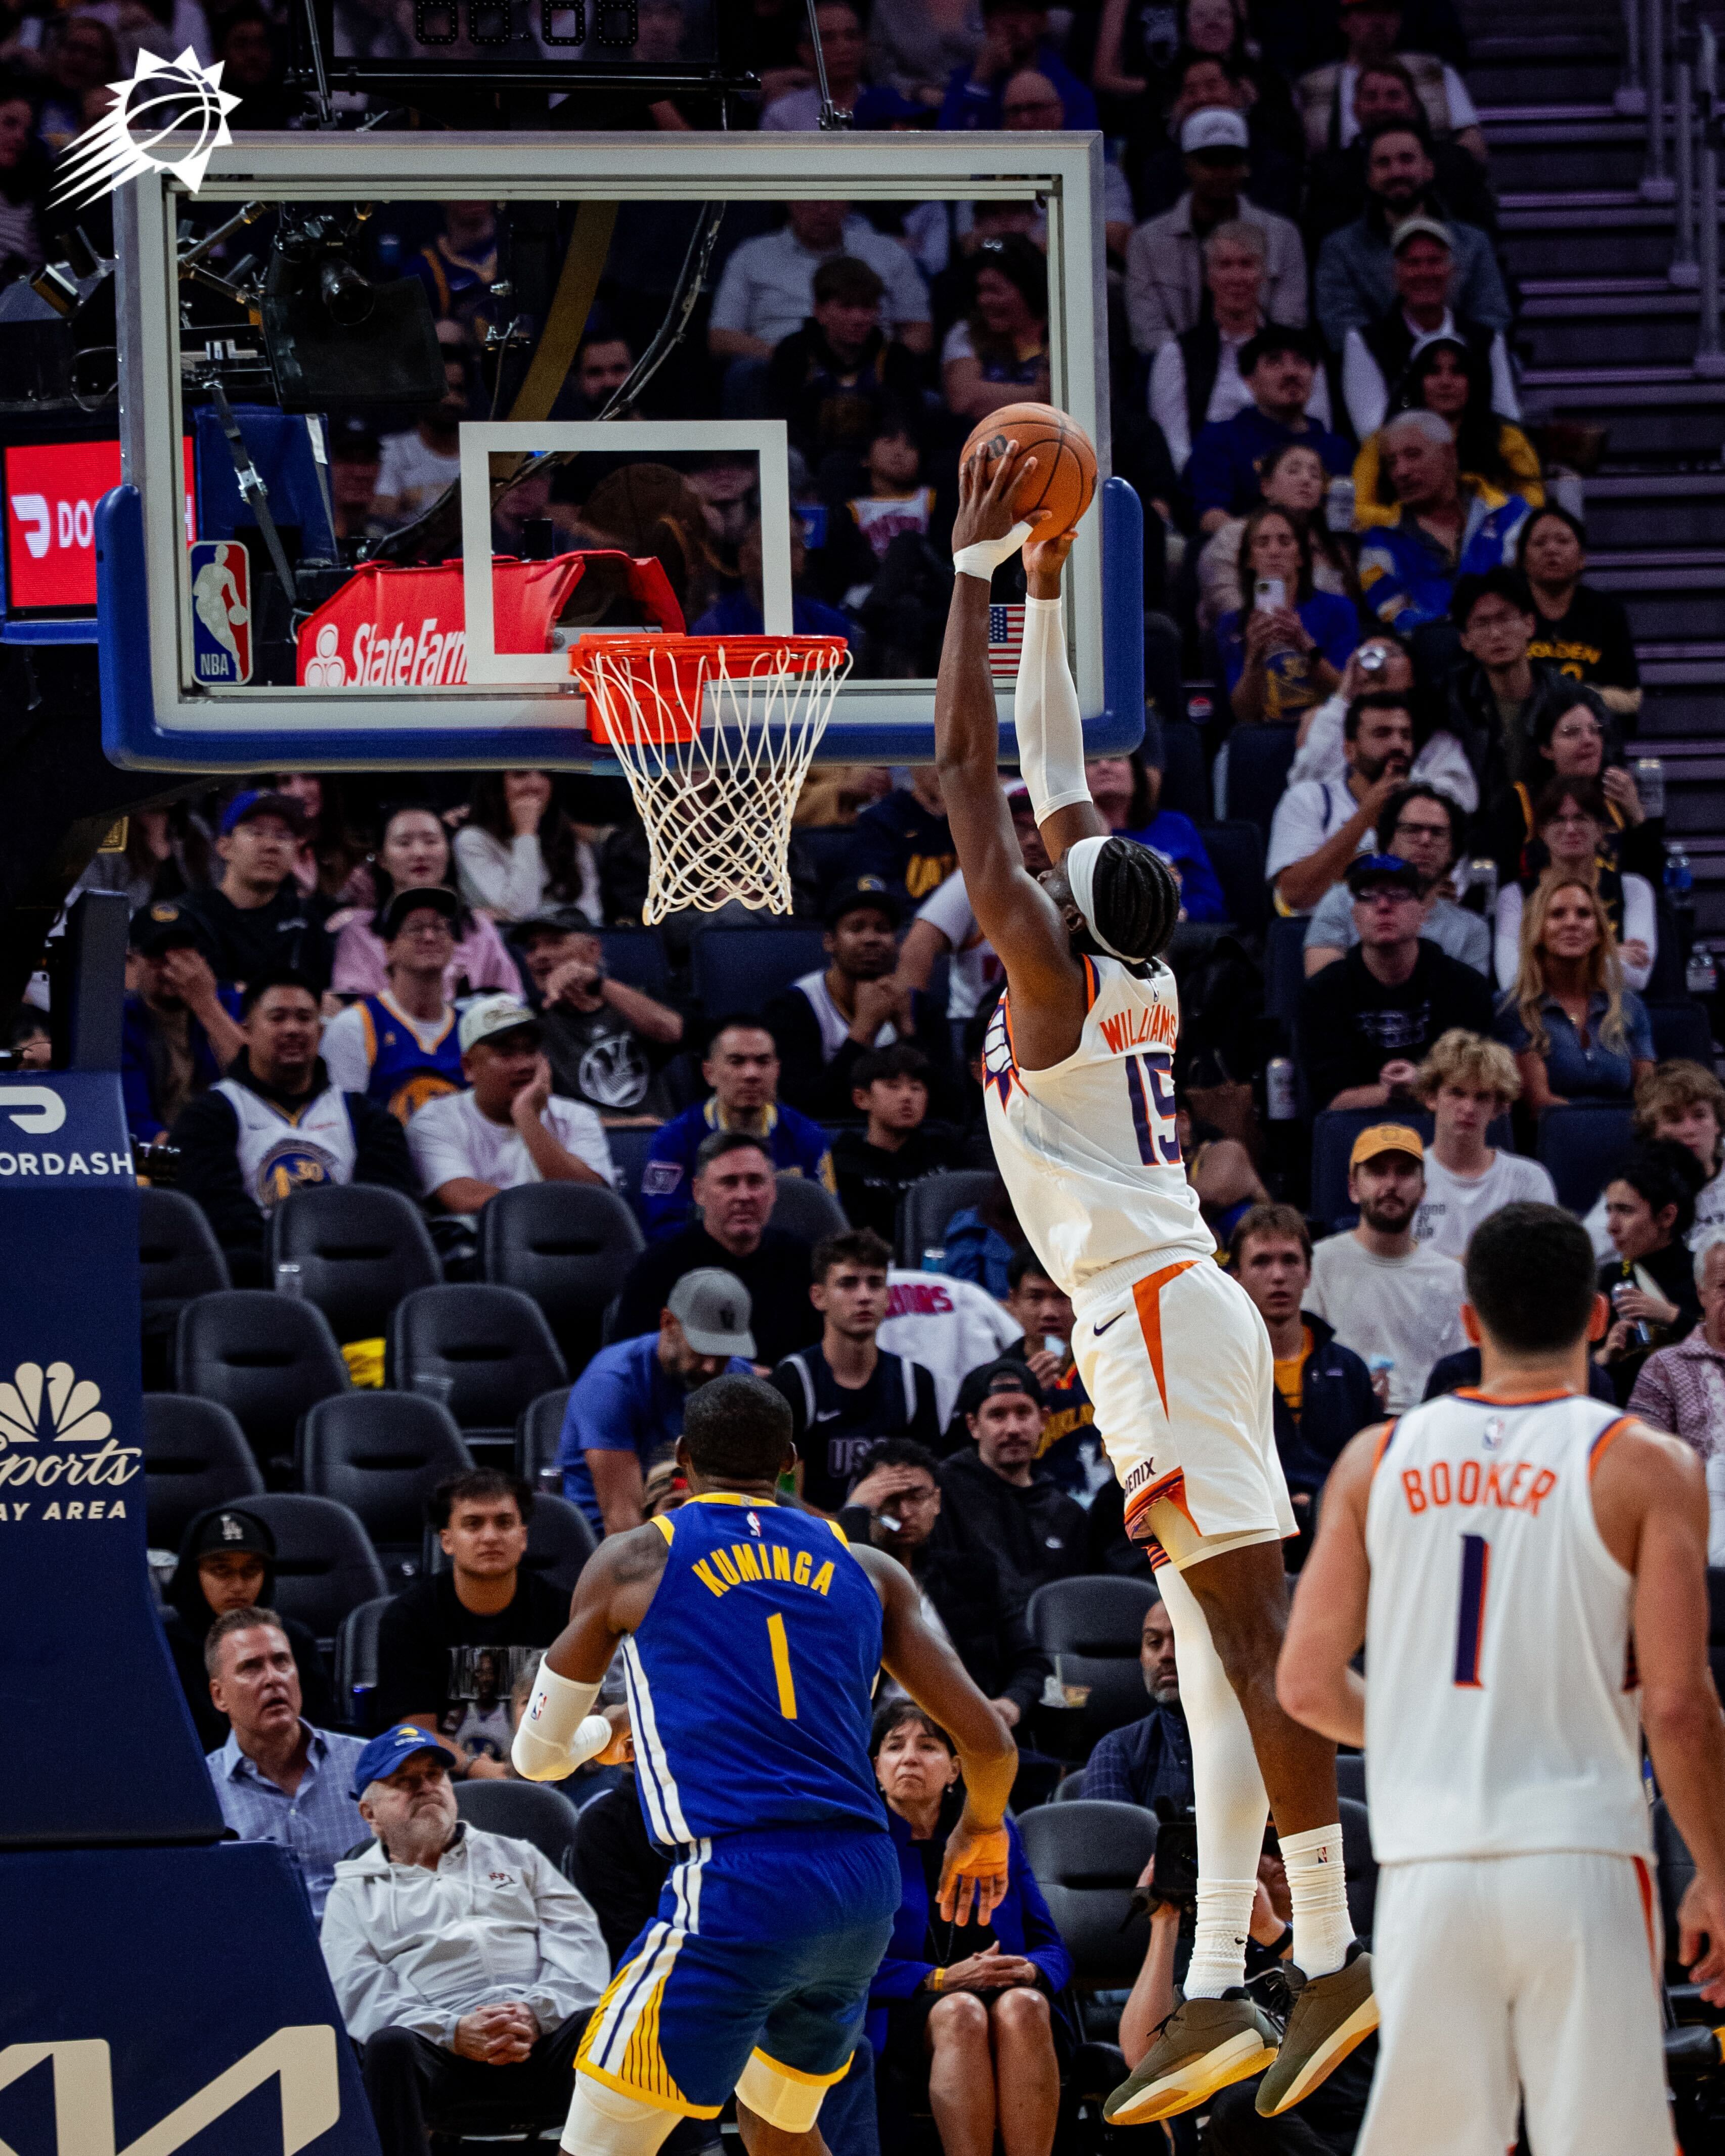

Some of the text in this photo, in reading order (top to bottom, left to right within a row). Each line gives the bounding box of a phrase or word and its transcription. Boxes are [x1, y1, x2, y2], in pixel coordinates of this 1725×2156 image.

[200, 653, 230, 676] NBA
[1525, 640, 1603, 665] OLDEN
[1099, 1004, 1177, 1054] WILLIAMS
[1125, 1052, 1182, 1166] 15
[1125, 1456, 1157, 1499] ENIX
[1401, 1460, 1557, 1517] BOOKER
[41, 1500, 126, 1520] AREA
[691, 1543, 835, 1598] KUMINGA
[1452, 1533, 1492, 1690] 1
[766, 1611, 798, 1720] 1
